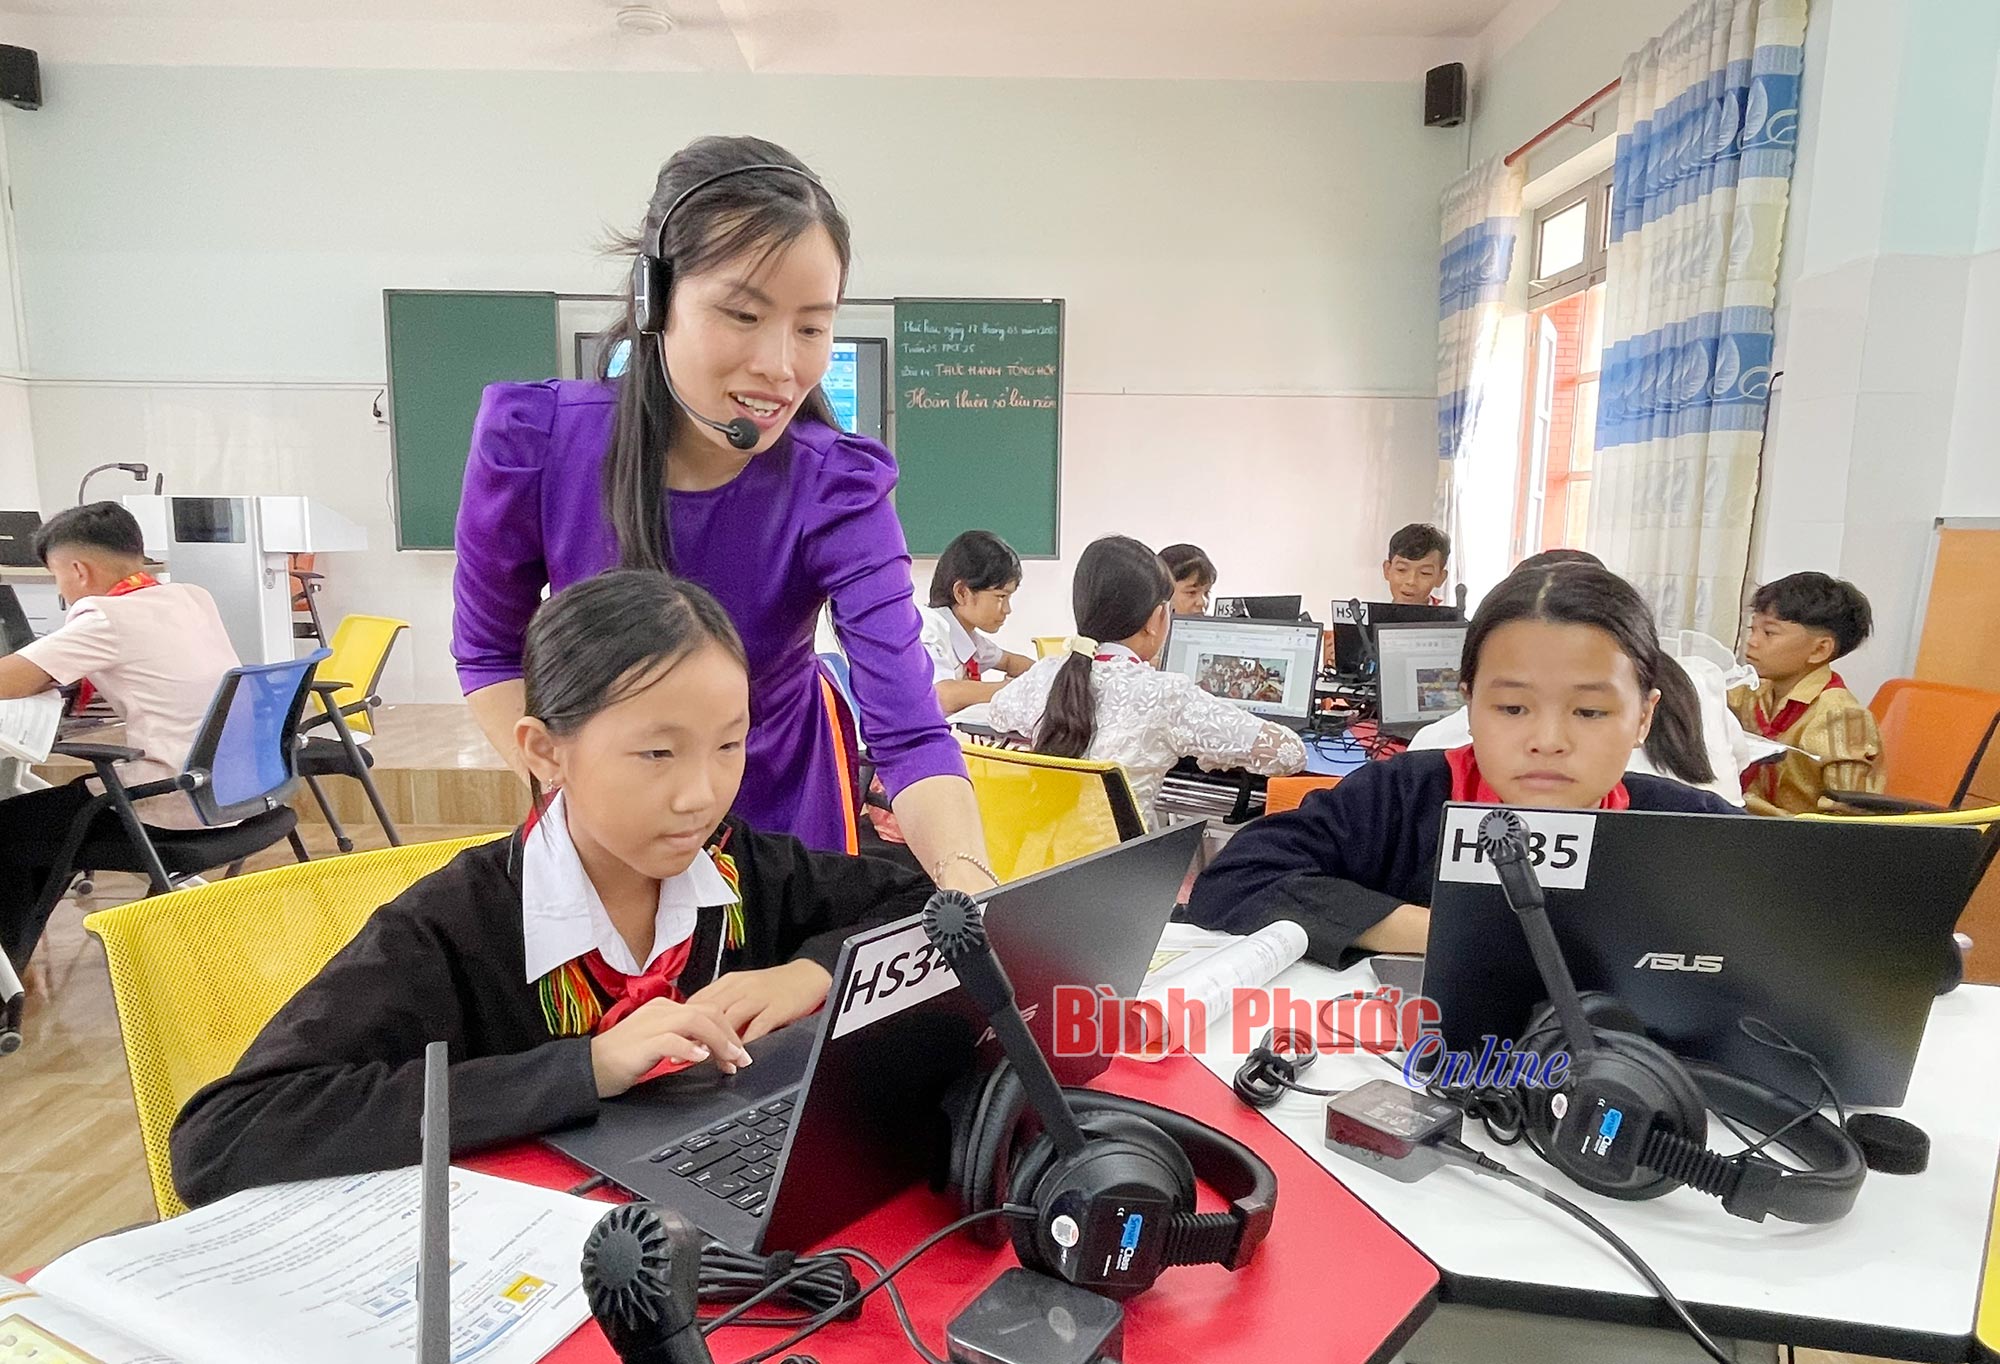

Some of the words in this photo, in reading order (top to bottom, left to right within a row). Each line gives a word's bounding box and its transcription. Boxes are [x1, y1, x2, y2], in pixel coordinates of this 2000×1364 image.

[1336, 607, 1367, 620] HS7
[1452, 828, 1579, 870] H35
[1633, 952, 1724, 973] ASUS
